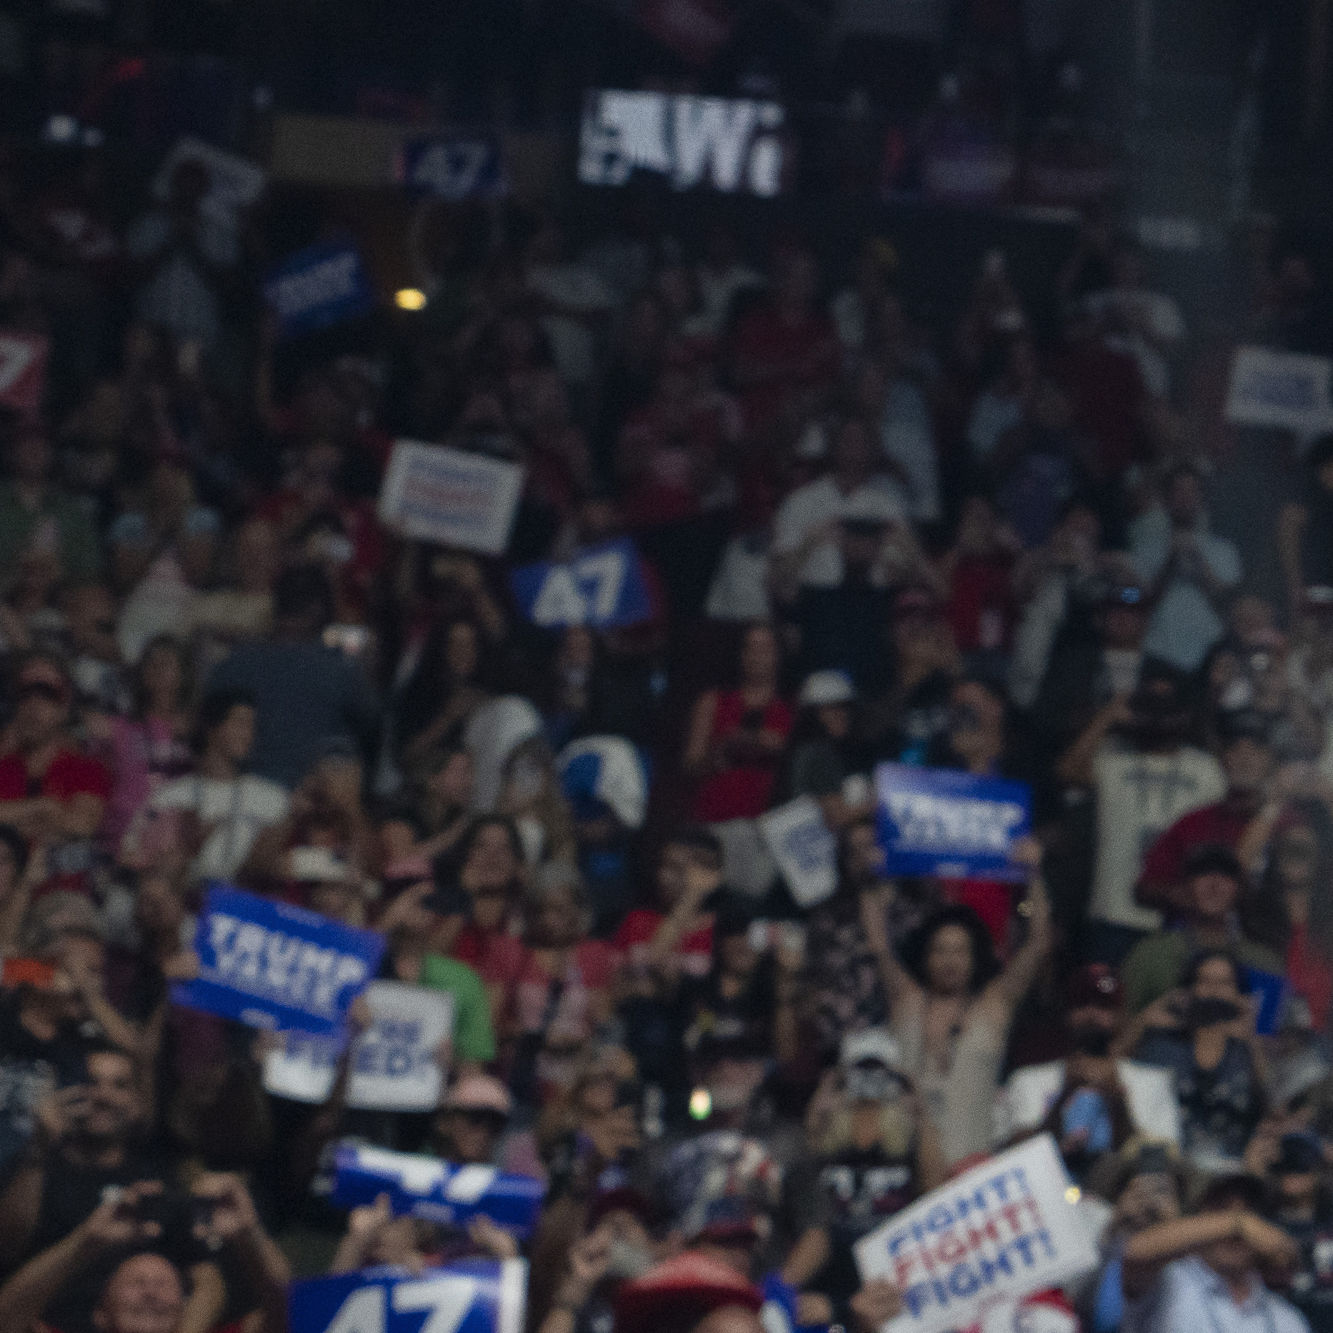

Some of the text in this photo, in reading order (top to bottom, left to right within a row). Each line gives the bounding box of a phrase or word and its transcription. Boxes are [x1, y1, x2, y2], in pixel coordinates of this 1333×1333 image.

[532, 551, 628, 628] 47
[206, 912, 370, 988] TRUMP
[888, 1166, 1031, 1256] FIGHT!
[894, 1196, 1042, 1286] FIGHT!
[903, 1228, 1056, 1318] FIGHT!
